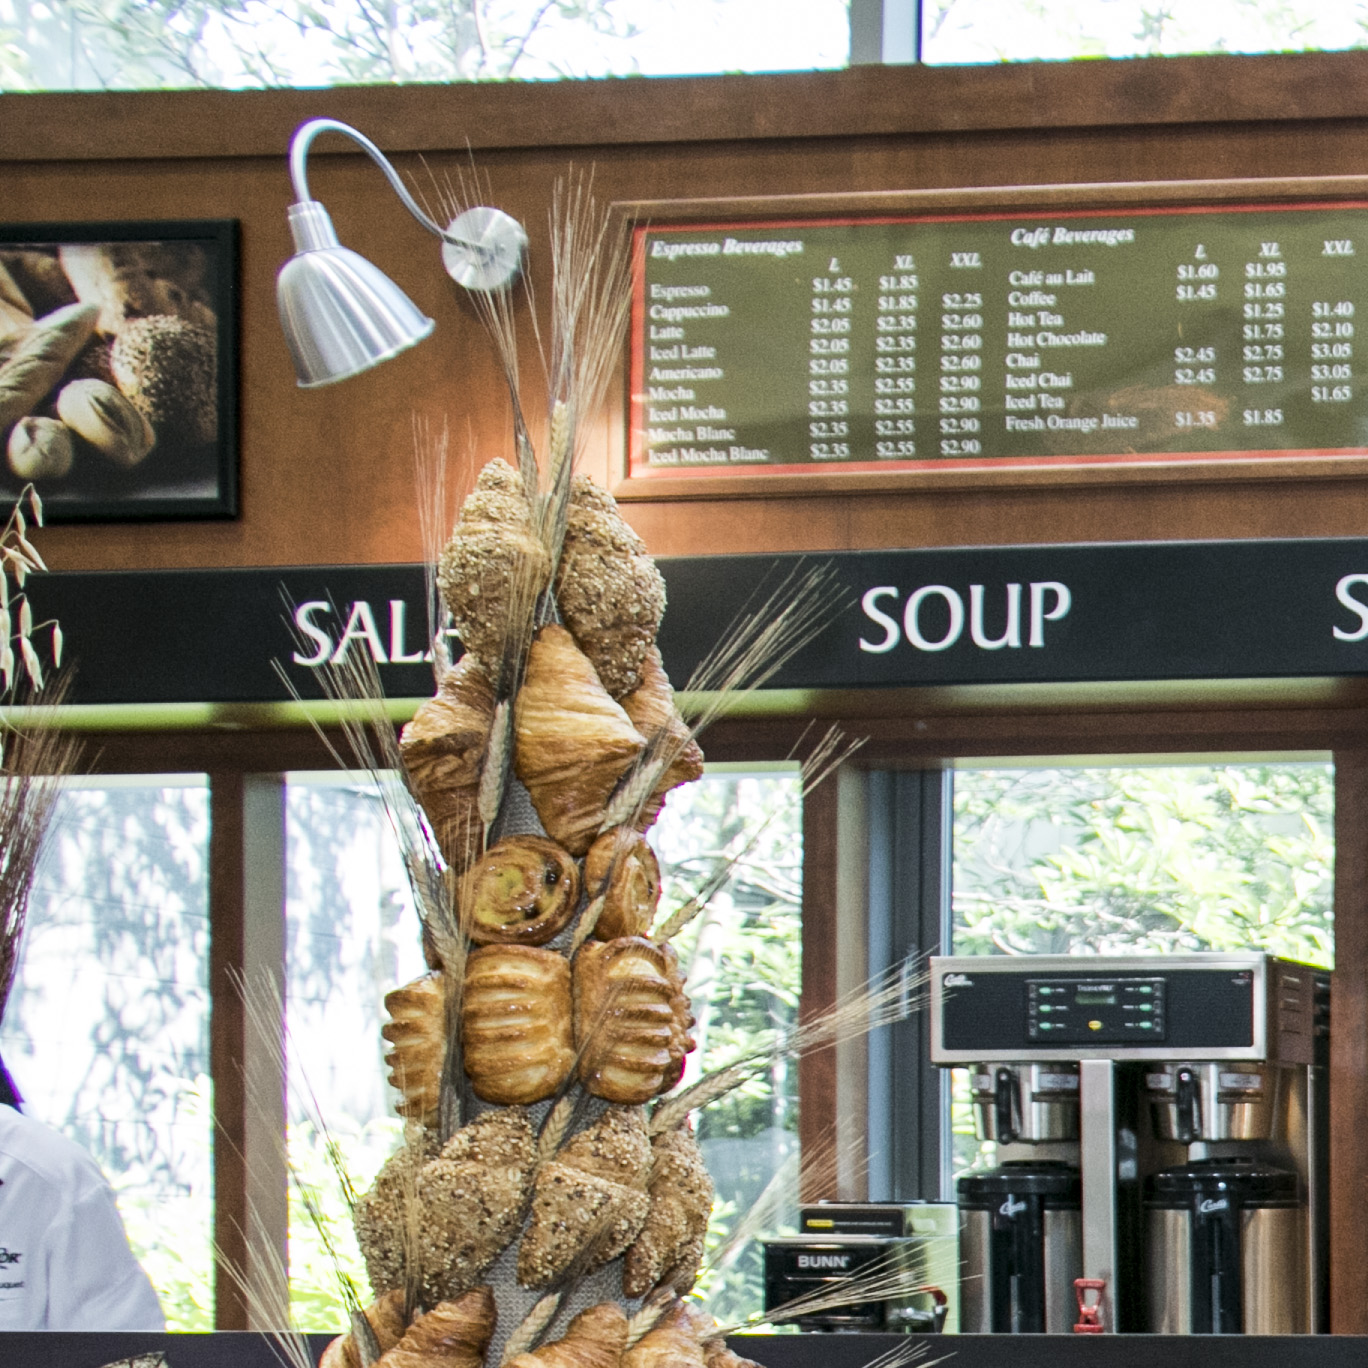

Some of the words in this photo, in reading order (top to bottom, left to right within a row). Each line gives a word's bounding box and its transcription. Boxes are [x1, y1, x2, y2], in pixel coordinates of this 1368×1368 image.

[1009, 226, 1051, 250] Café
[1051, 226, 1135, 247] Beverages
[650, 240, 722, 262] Espresso
[720, 237, 804, 258] Beverages
[1258, 241, 1282, 259] XL
[1321, 239, 1355, 257] XXL
[893, 254, 916, 271] XL
[949, 251, 983, 269] XXL
[1176, 263, 1220, 281] $1.60
[1244, 261, 1287, 279] $1.95
[812, 276, 853, 294] $1.45
[878, 274, 919, 292] $1.85
[1008, 270, 1045, 287] Café
[1044, 273, 1065, 287] au
[1064, 268, 1096, 286] Lait
[650, 283, 712, 302] Espresso
[1007, 290, 1057, 308] Coffee
[1175, 283, 1218, 302] $1.45
[1244, 281, 1286, 300] $1.65
[648, 302, 731, 323] Cappuccino
[811, 297, 852, 314] $1.45
[877, 294, 918, 312] $1.85
[942, 292, 983, 310] $2.25
[1243, 302, 1285, 320] $1.25
[1311, 301, 1355, 319] $1.40
[810, 317, 851, 335] $2.05
[876, 314, 917, 333] $2.35
[941, 313, 984, 331] $2.60
[1007, 311, 1036, 328] Hot
[1036, 310, 1065, 327] Tea
[649, 324, 685, 341] Latte
[1006, 332, 1035, 349] Hot
[1035, 329, 1108, 348] Chocolate
[1242, 323, 1285, 341] $1.75
[1311, 321, 1355, 339] $2.10
[649, 345, 680, 361] Iced
[681, 344, 716, 360] Latte
[809, 337, 850, 355] $2.05
[875, 335, 917, 353] $2.35
[940, 333, 983, 352] $2.60
[1174, 346, 1216, 364] $2.45
[1242, 344, 1284, 362] $2.75
[1310, 342, 1353, 360] $3.05
[809, 358, 850, 376] $2.05
[875, 356, 916, 374] $2.35
[940, 354, 982, 372] $2.60
[1004, 352, 1041, 370] Chai
[648, 365, 724, 382] Americano
[1005, 372, 1037, 390] Iced
[1035, 371, 1073, 389] Chai
[1174, 367, 1216, 385] $2.45
[1242, 365, 1284, 384] $2.75
[1310, 363, 1353, 382] $3.05
[647, 385, 696, 402] Mocha
[808, 379, 849, 397] $2.35
[874, 376, 916, 395] $2.55
[939, 375, 982, 393] $2.90
[1311, 385, 1353, 403] $1.65
[808, 399, 849, 417] $2.35
[874, 397, 915, 416] $2.55
[938, 396, 981, 414] $2.90
[1004, 393, 1037, 411] Iced
[1037, 392, 1066, 410] Tea
[648, 406, 679, 423] Iced
[679, 404, 727, 421] Mocha
[1005, 415, 1047, 432] Fresh
[1046, 414, 1099, 434] Orange
[1100, 413, 1139, 430] Juice
[1242, 408, 1284, 427] $1.85
[647, 427, 695, 445] Mocha
[696, 425, 736, 442] Blanc
[809, 421, 849, 439] $2.35
[874, 419, 916, 437] $2.55
[939, 417, 981, 435] $2.90
[648, 449, 679, 464] Iced
[680, 447, 727, 463] Mocha
[728, 446, 770, 462] Blanc
[809, 442, 850, 460] $2.35
[875, 440, 916, 458] $2.55
[940, 439, 982, 456] $2.90
[858, 580, 1072, 654] SOUP
[798, 1255, 847, 1268] BUNN
